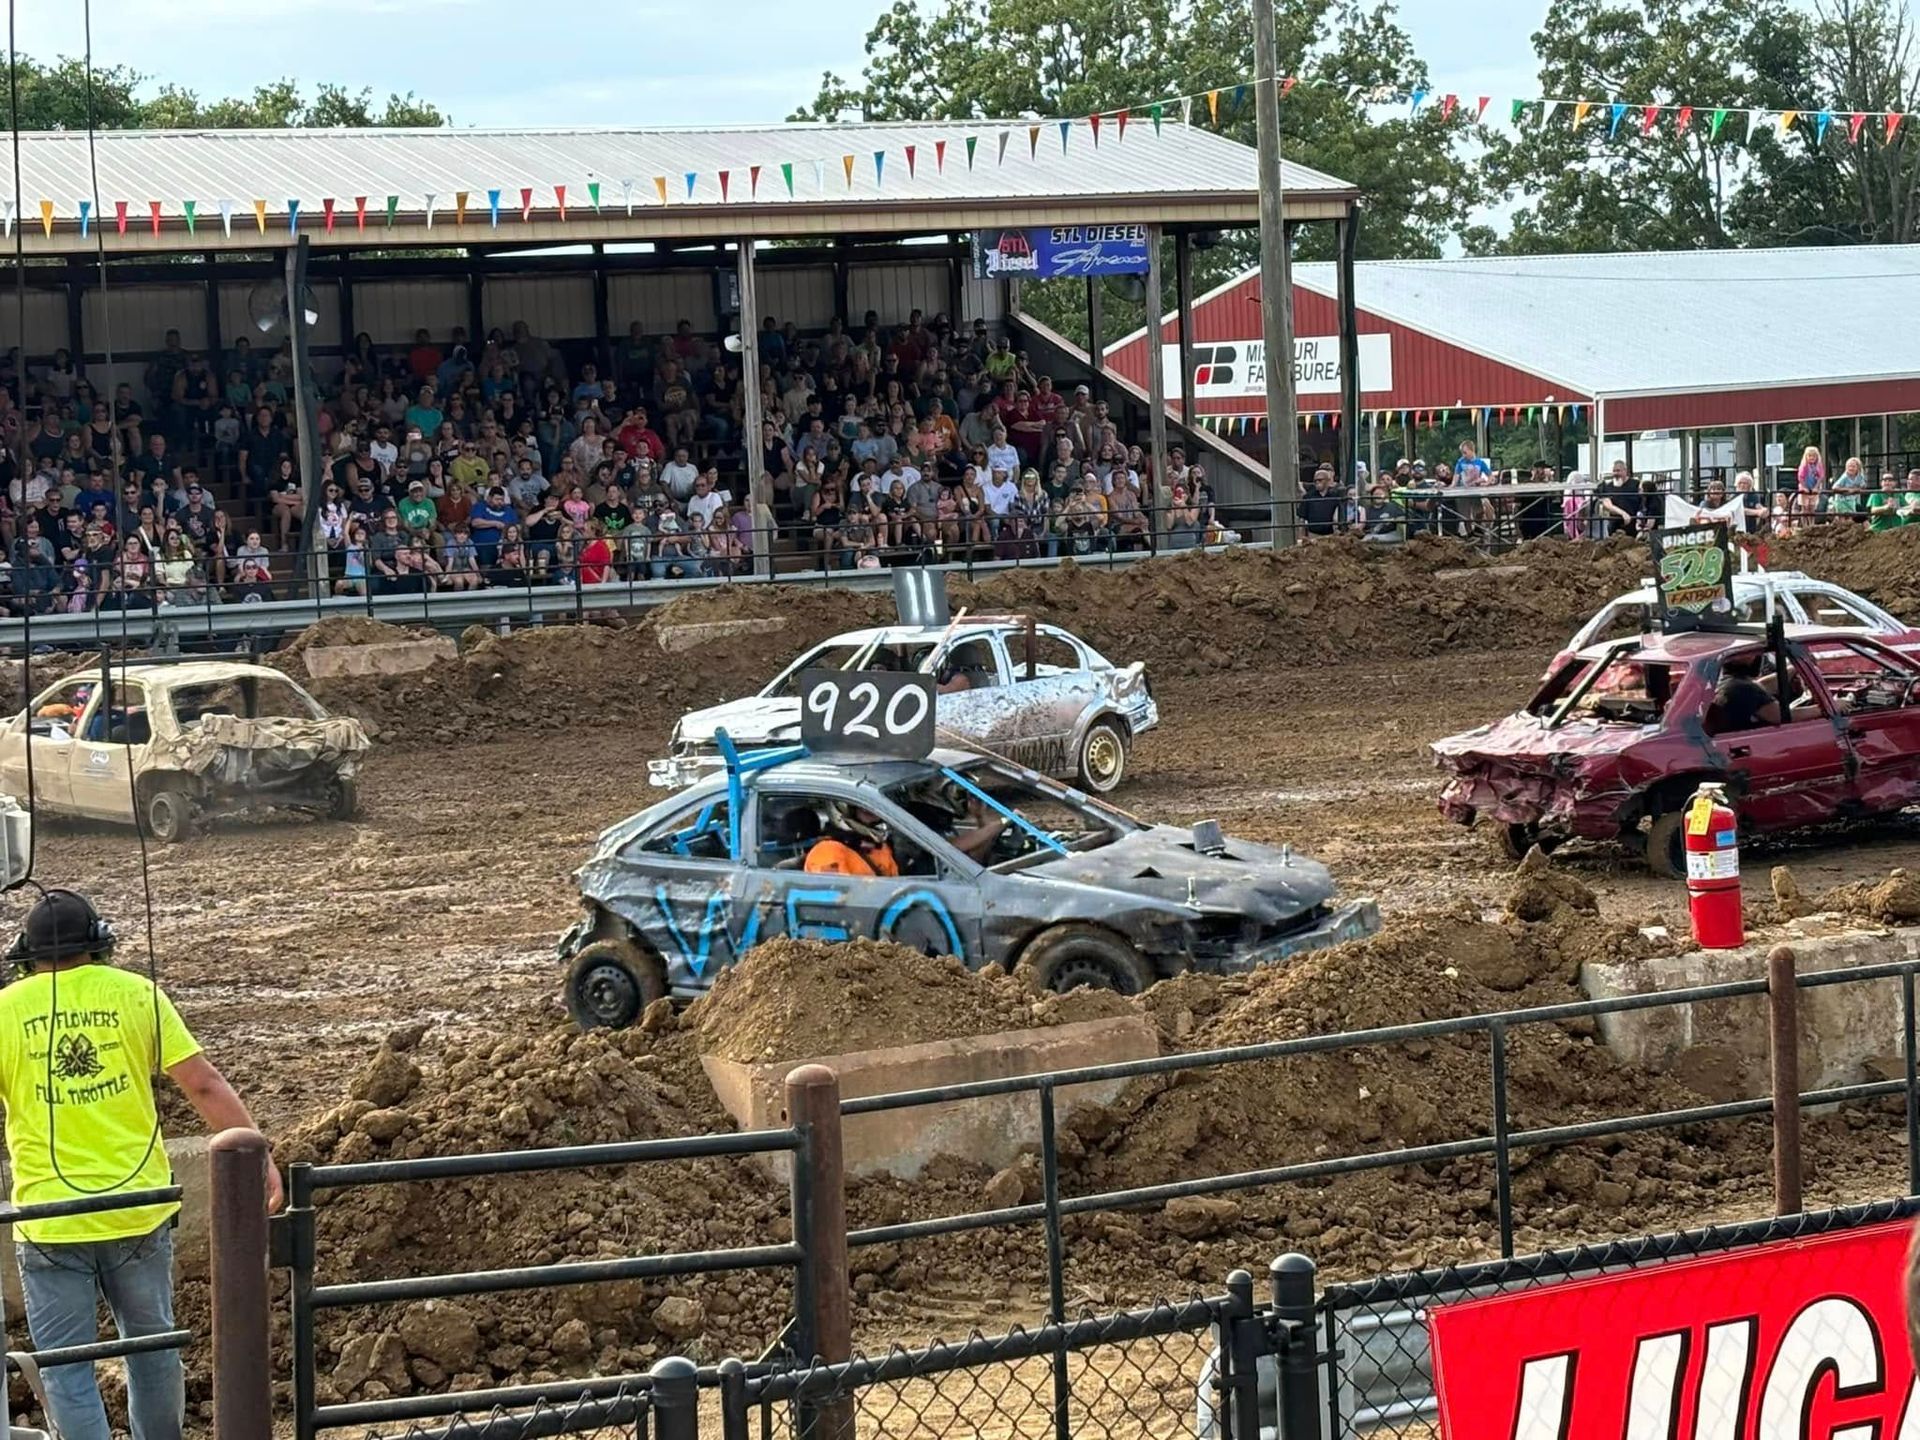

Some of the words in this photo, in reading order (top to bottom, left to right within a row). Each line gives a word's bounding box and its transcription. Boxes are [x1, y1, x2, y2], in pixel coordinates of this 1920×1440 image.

[1050, 227, 1082, 245] STL
[1085, 224, 1147, 243] DIESEL
[1294, 361, 1344, 381] BUREA
[1660, 546, 1725, 591] 528
[808, 681, 929, 739] 920
[55, 1009, 120, 1030] FLOWERS
